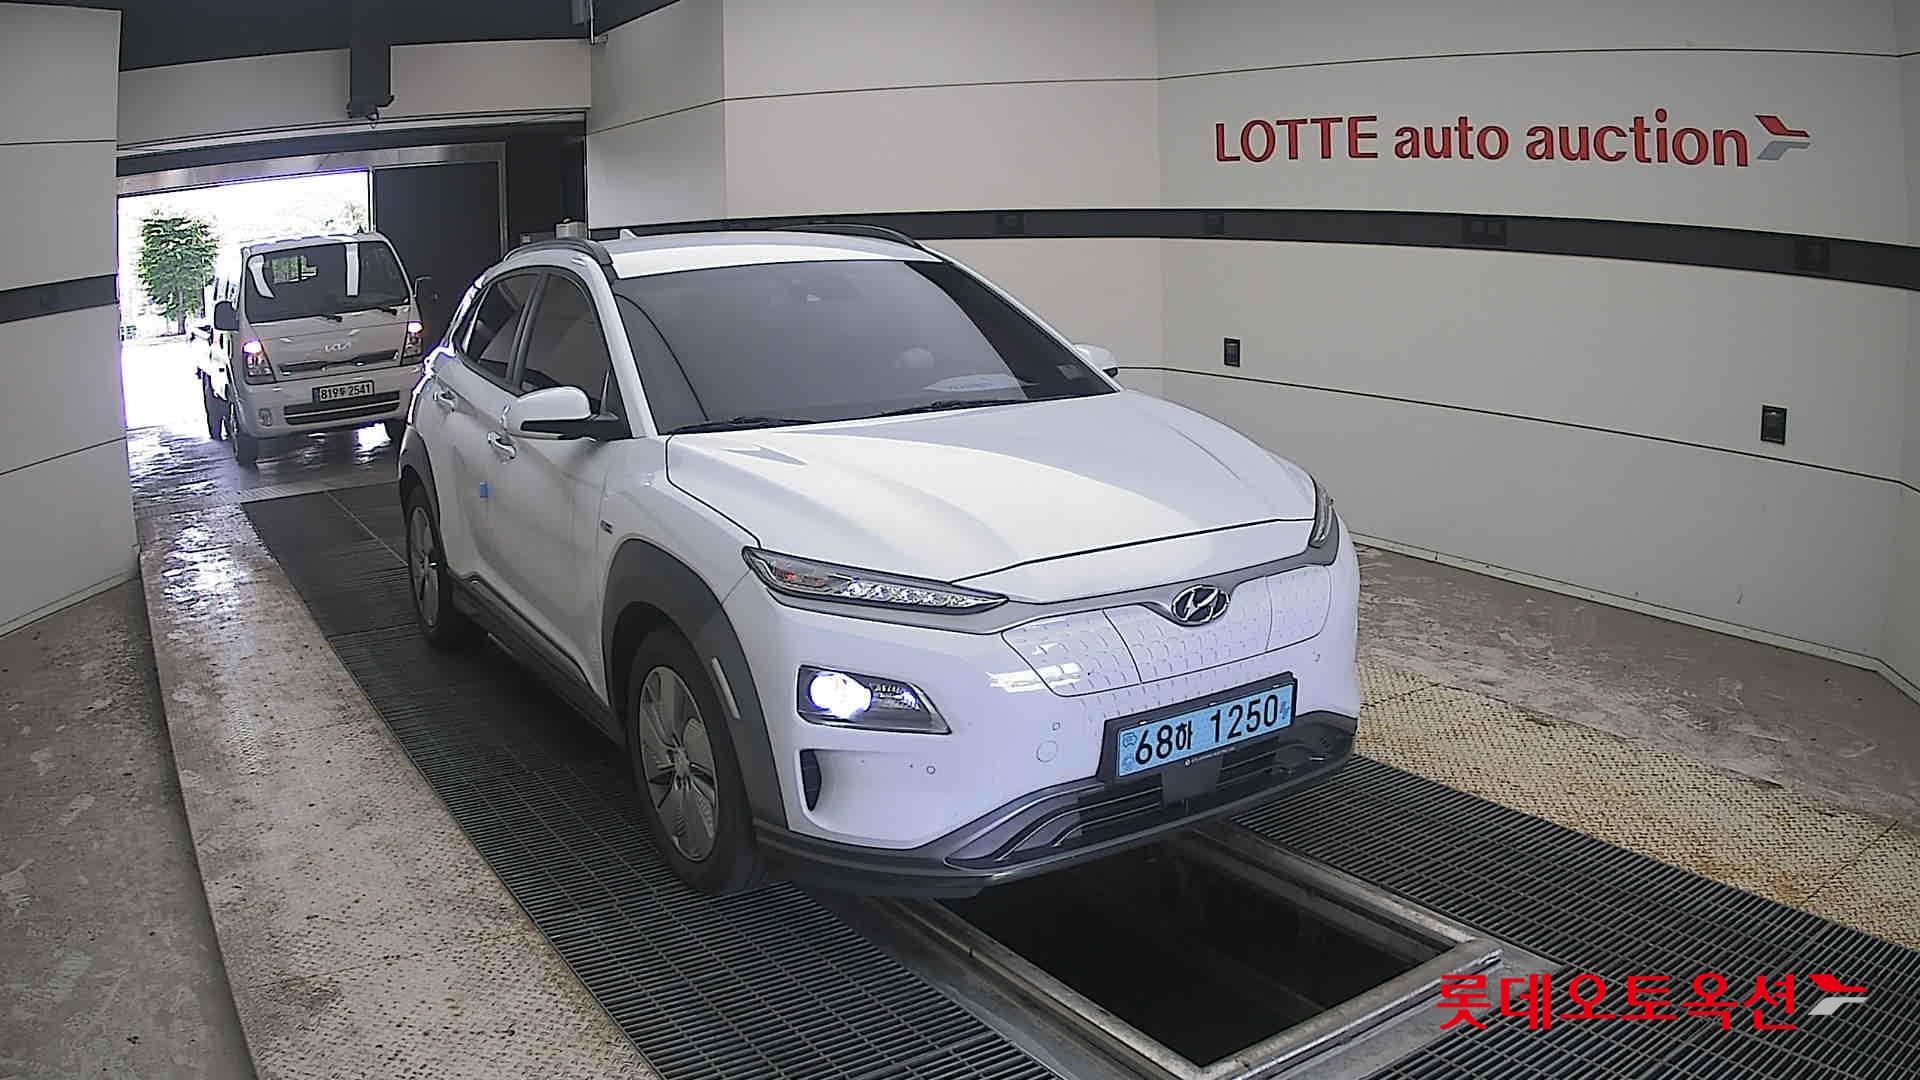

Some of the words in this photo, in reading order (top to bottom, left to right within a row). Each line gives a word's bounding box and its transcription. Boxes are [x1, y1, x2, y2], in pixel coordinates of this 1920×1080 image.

[1215, 115, 1378, 162] LOTTE
[1394, 115, 1509, 160] auto
[1525, 108, 1749, 167] auction
[1135, 720, 1193, 765] 68하
[1210, 694, 1278, 743] 1250
